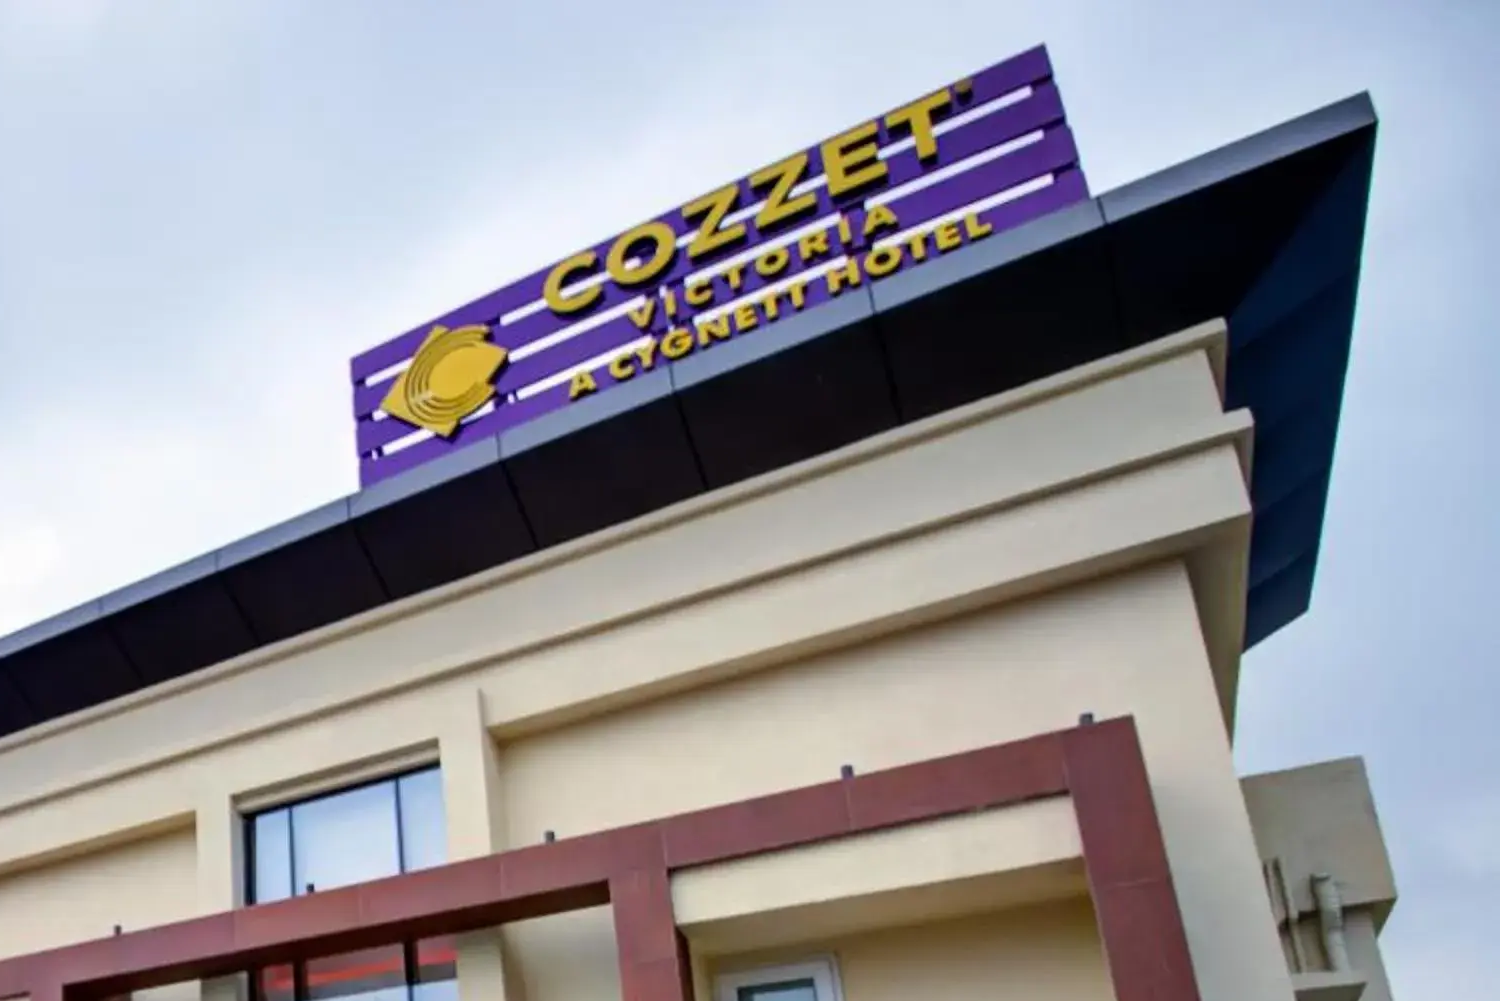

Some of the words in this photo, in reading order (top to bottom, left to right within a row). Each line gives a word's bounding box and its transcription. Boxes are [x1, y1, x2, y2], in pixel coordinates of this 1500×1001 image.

[543, 88, 951, 313] COZZET
[629, 205, 897, 329] VICTORIA
[568, 370, 596, 398] A
[611, 282, 807, 379] CYGNETT
[827, 213, 993, 294] HOTEL
